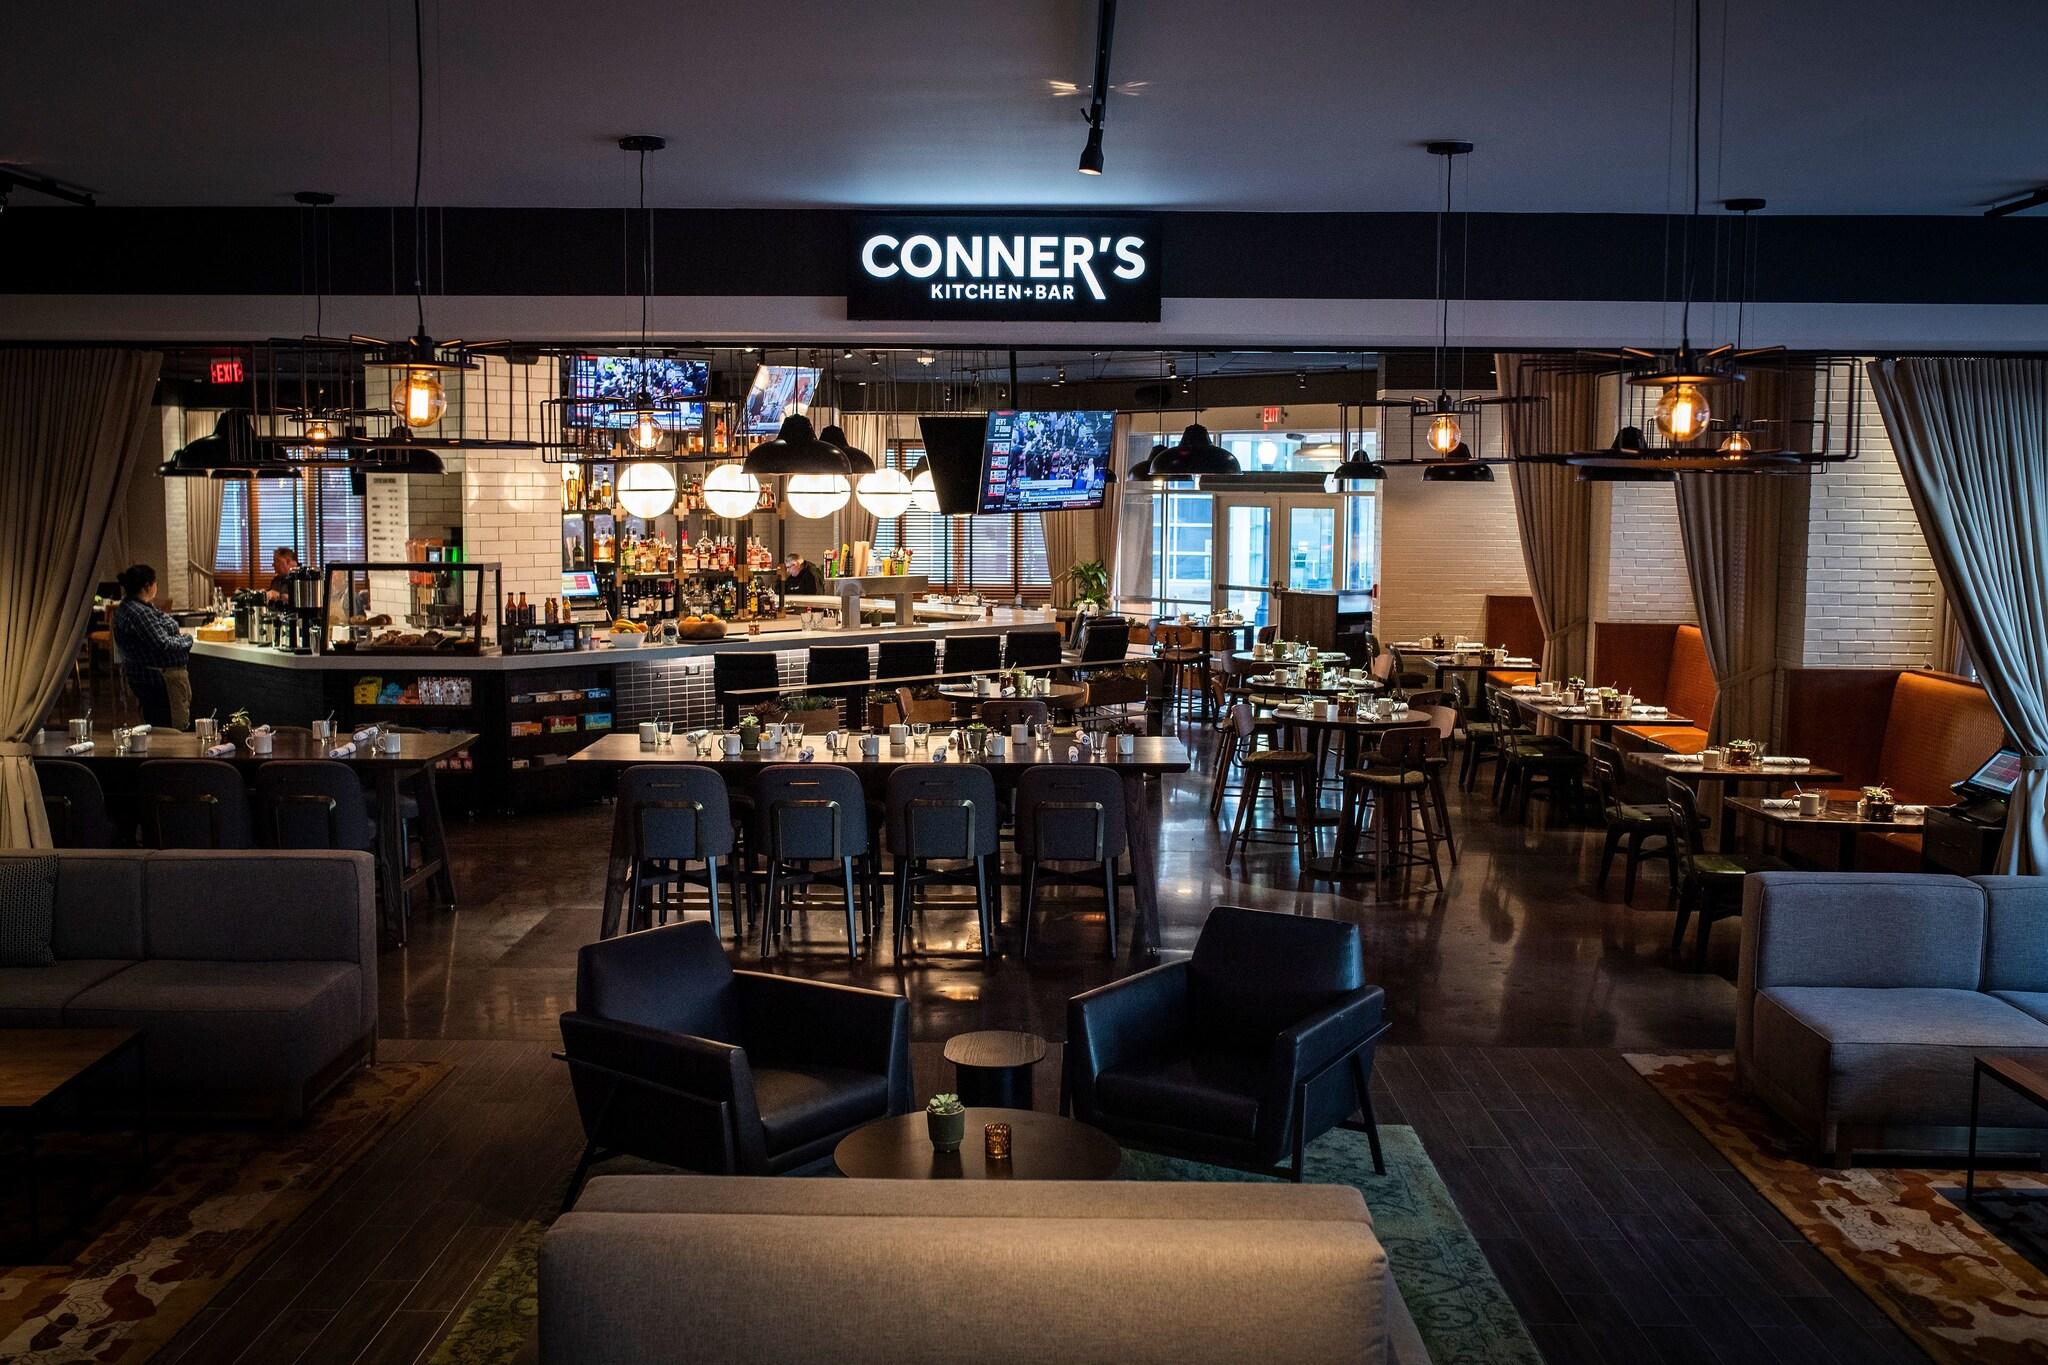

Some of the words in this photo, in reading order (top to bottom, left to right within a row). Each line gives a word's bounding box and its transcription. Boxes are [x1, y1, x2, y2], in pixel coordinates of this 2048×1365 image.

[861, 234, 1146, 300] CONNER'S
[216, 363, 239, 383] EXIT
[1263, 407, 1280, 423] EXIT
